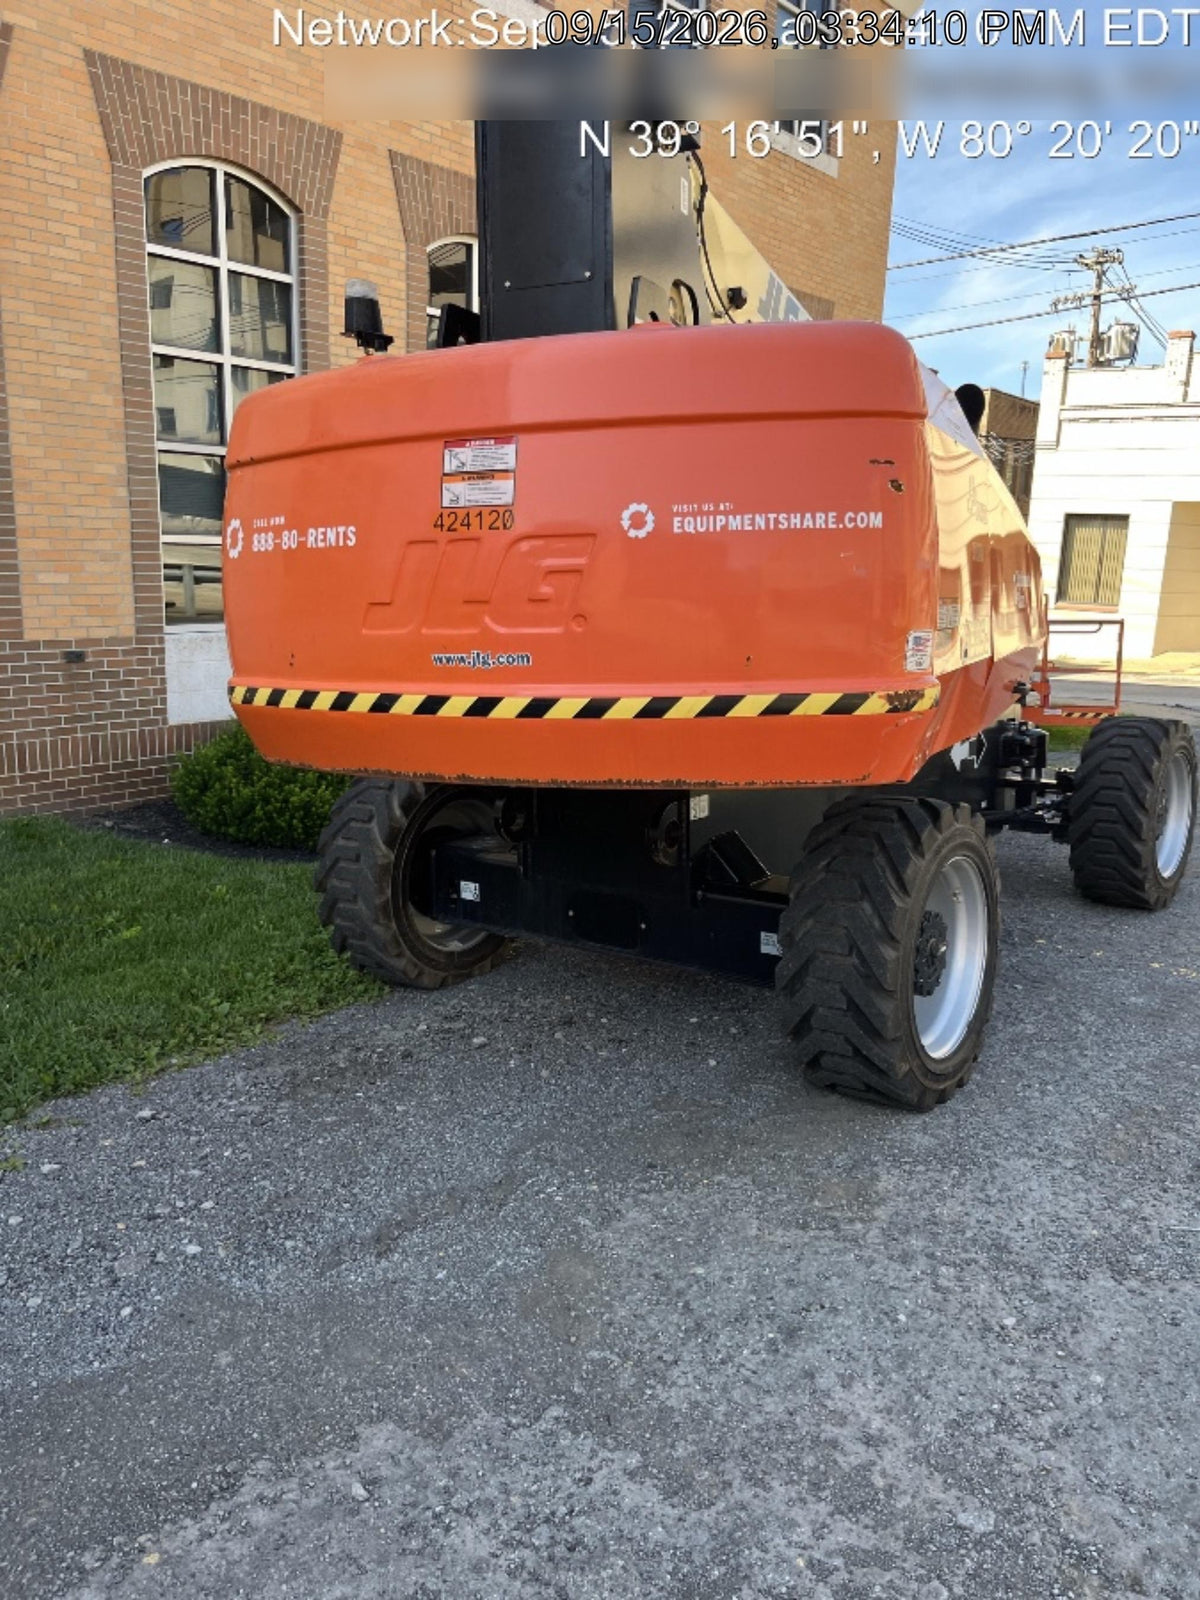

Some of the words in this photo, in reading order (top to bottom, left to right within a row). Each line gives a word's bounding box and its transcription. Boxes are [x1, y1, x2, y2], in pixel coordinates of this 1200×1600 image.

[672, 504, 698, 513] VISIT
[701, 502, 714, 512] US
[433, 509, 514, 533] 424120
[672, 510, 884, 535] EQUIPMENTSHARE.COM
[252, 525, 357, 553] 888-80-RENTS
[431, 649, 533, 670] www.jlg.com
